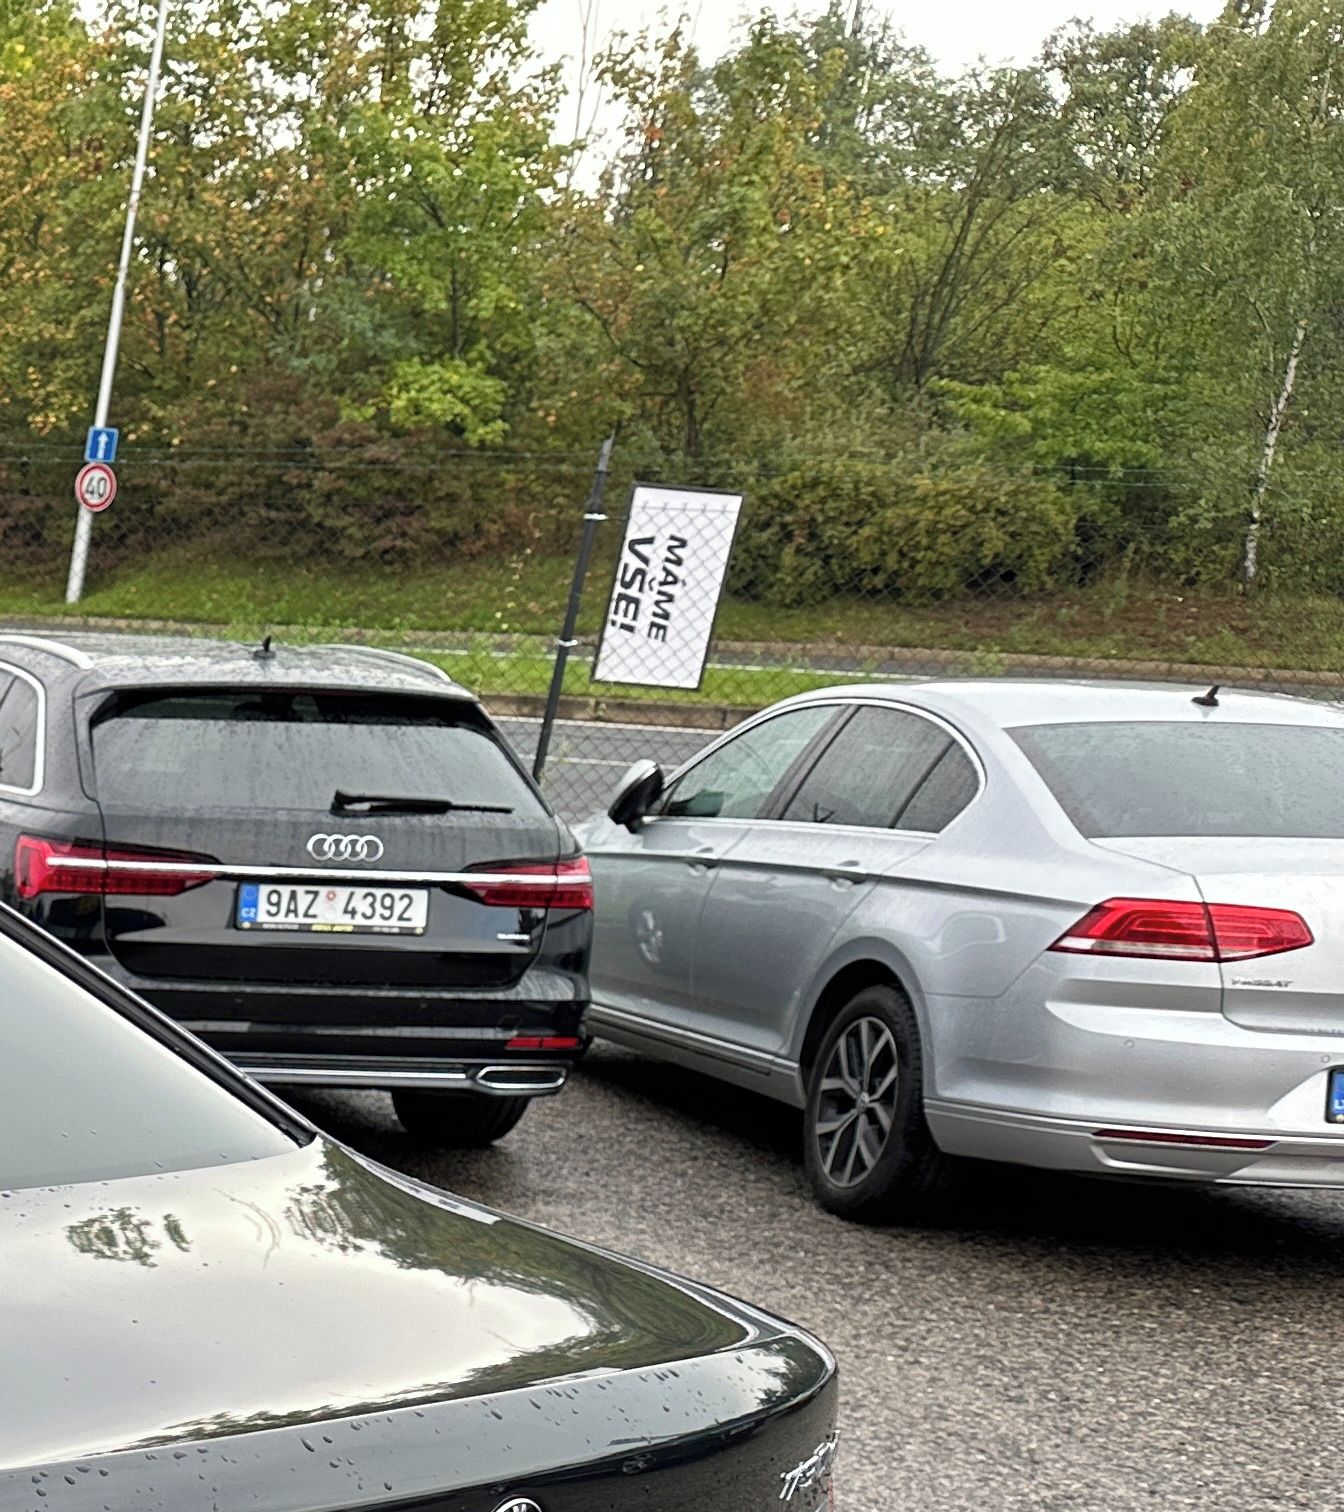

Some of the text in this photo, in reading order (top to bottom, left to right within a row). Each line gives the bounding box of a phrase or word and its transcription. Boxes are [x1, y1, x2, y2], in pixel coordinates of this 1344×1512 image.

[86, 476, 107, 498] 40
[612, 535, 656, 634] VŠE!
[648, 534, 687, 643] MÁME
[241, 907, 256, 918] CZ
[266, 889, 414, 922] 9AZ 4392
